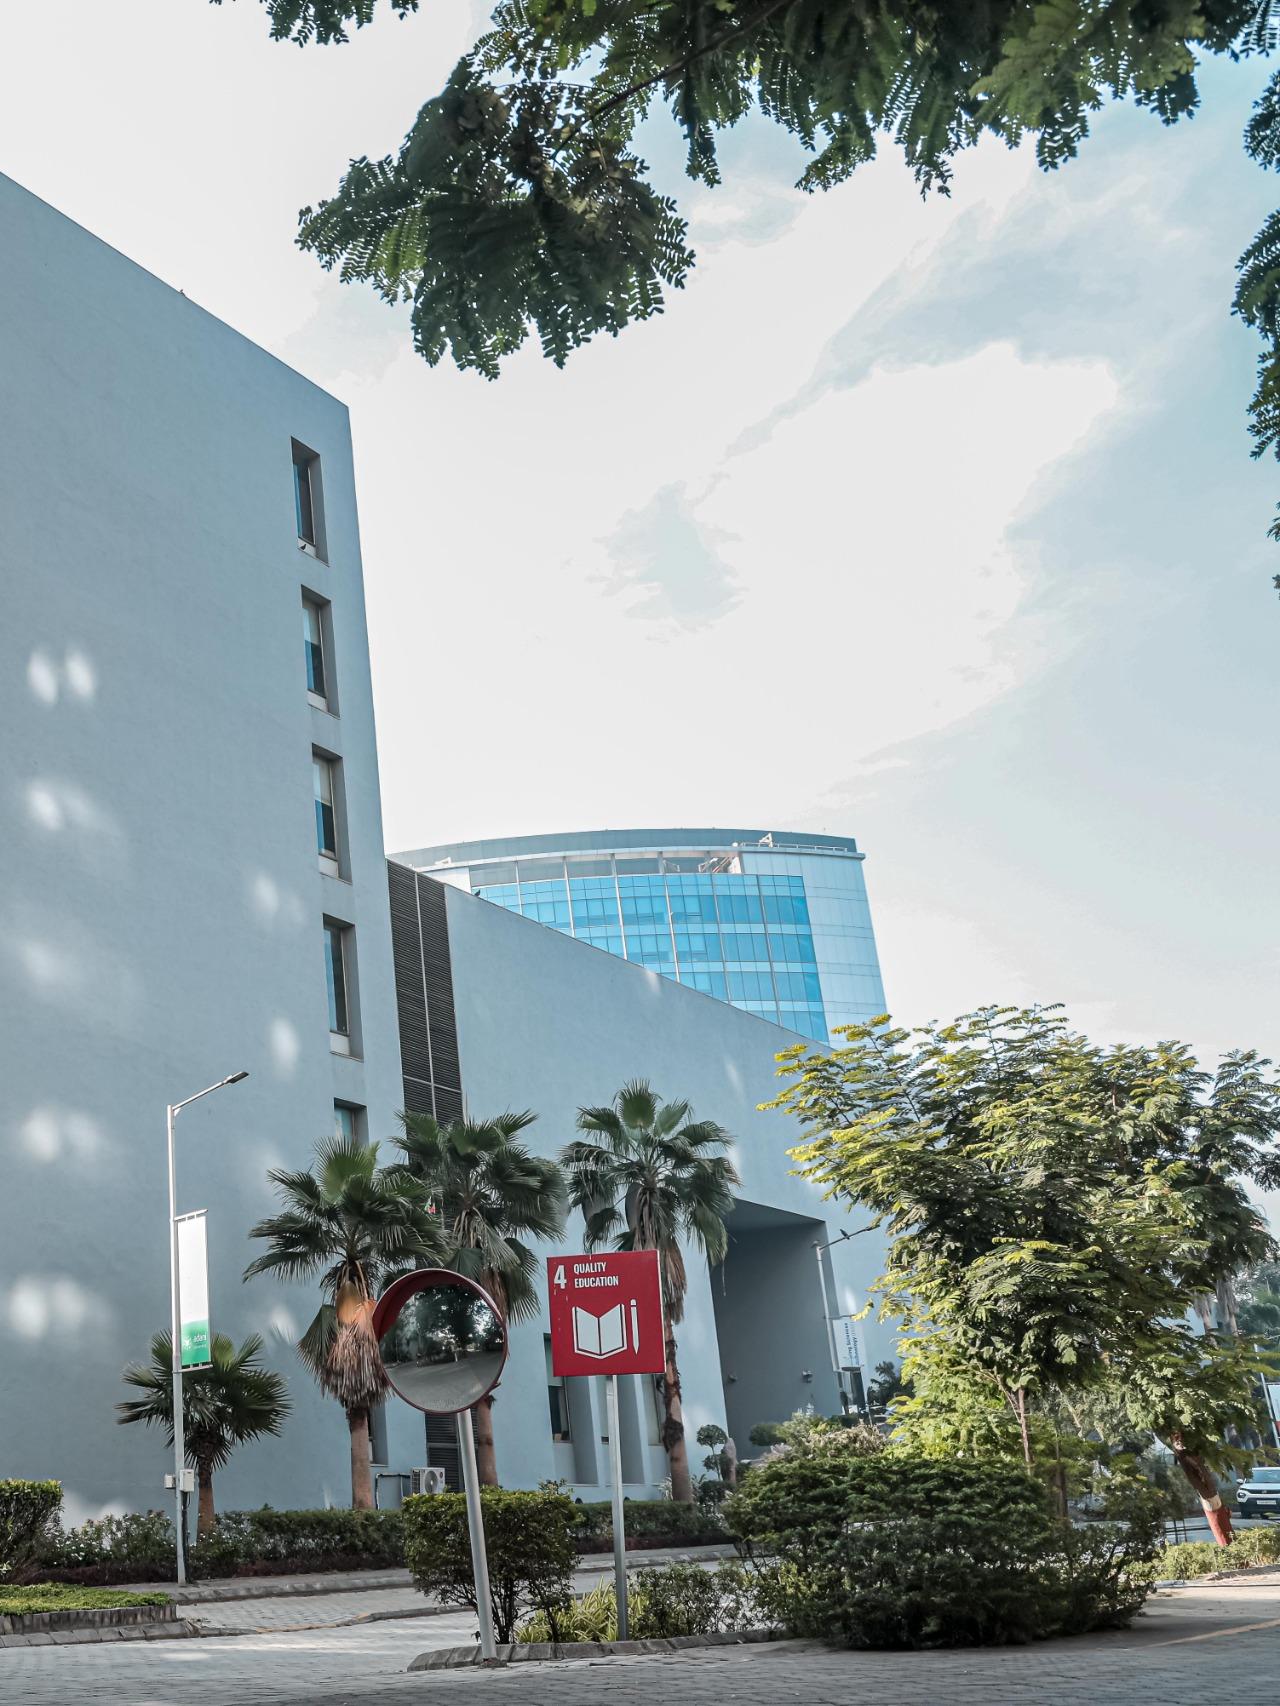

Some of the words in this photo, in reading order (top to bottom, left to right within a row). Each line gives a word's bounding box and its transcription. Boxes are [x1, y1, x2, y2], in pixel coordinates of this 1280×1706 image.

[573, 1262, 607, 1275] QUALITY
[554, 1265, 567, 1289] 4
[574, 1276, 619, 1289] EDUCATION
